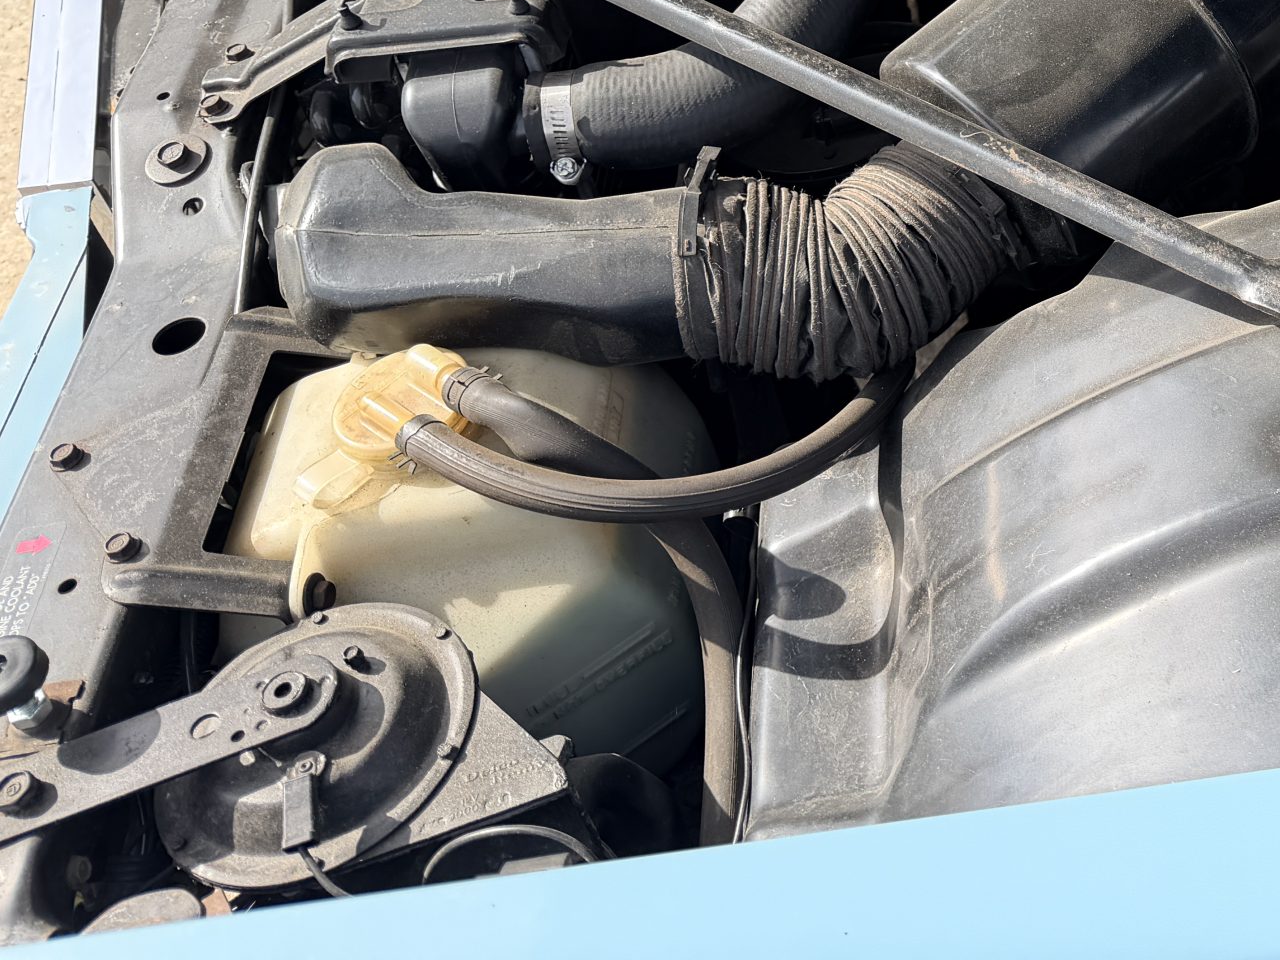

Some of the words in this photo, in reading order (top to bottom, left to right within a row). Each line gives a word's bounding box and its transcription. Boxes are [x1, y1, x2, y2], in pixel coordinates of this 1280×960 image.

[0, 575, 14, 597] AND
[4, 566, 31, 613] COOLANT
[16, 602, 30, 617] TO
